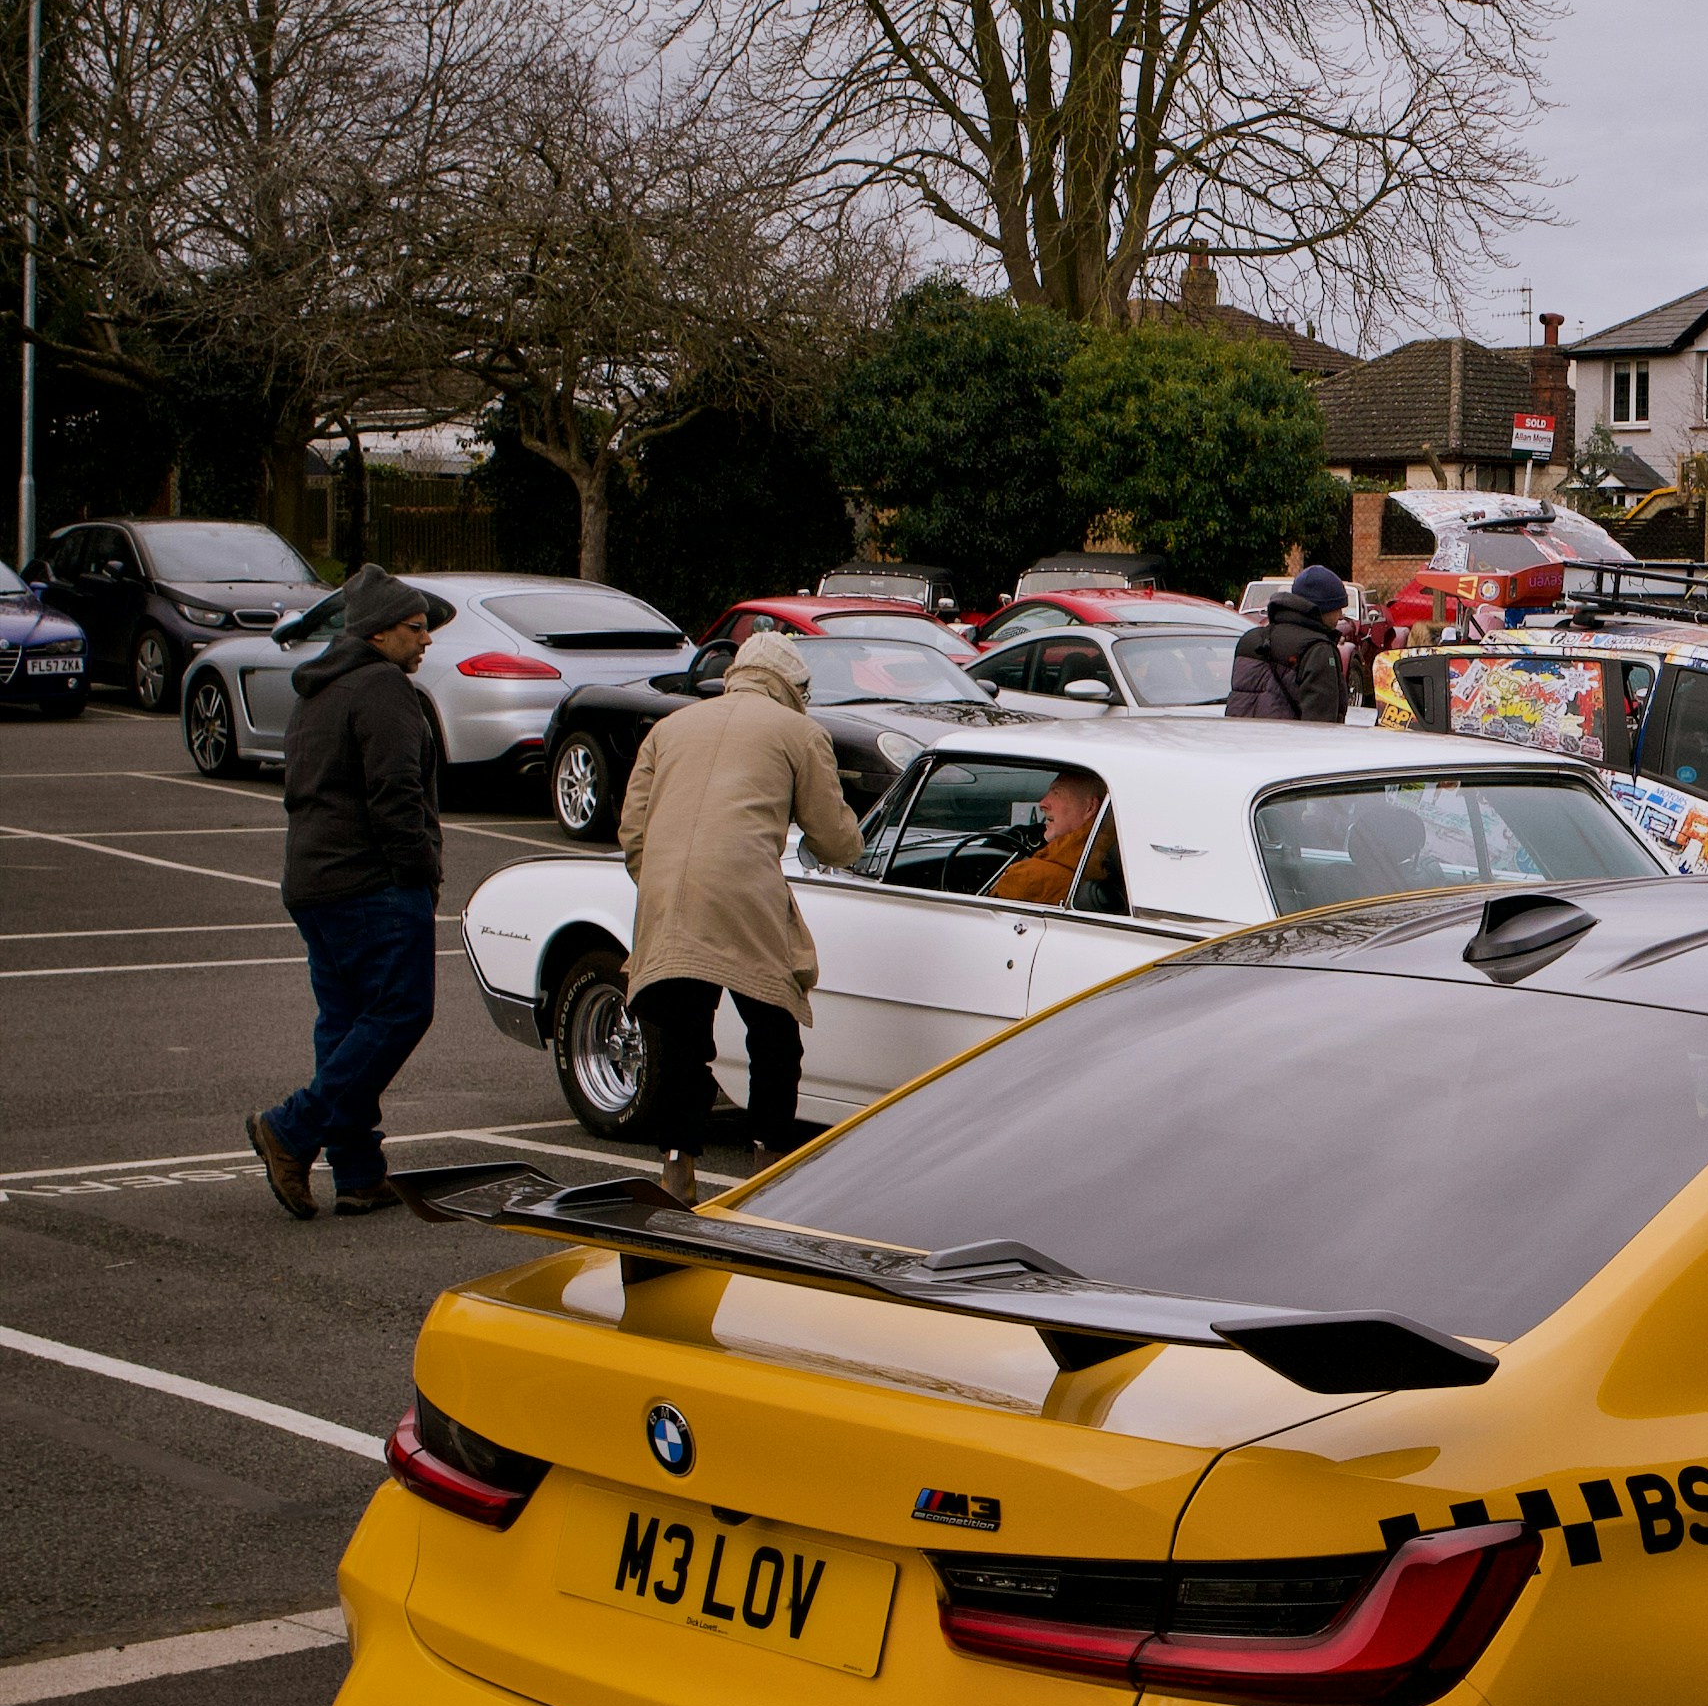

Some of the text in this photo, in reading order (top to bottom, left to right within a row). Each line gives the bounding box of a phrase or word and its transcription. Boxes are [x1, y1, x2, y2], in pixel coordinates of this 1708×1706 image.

[1525, 418, 1546, 428] SOLD
[1515, 433, 1531, 441] Allan
[31, 658, 81, 672] FL57 ZKA
[1655, 787, 1688, 806] MOTORS
[649, 1406, 688, 1433] BMW
[937, 1491, 1001, 1521] M3
[925, 1513, 995, 1530] competition
[614, 1511, 827, 1640] M3 LOV
[686, 1616, 699, 1627] Dick
